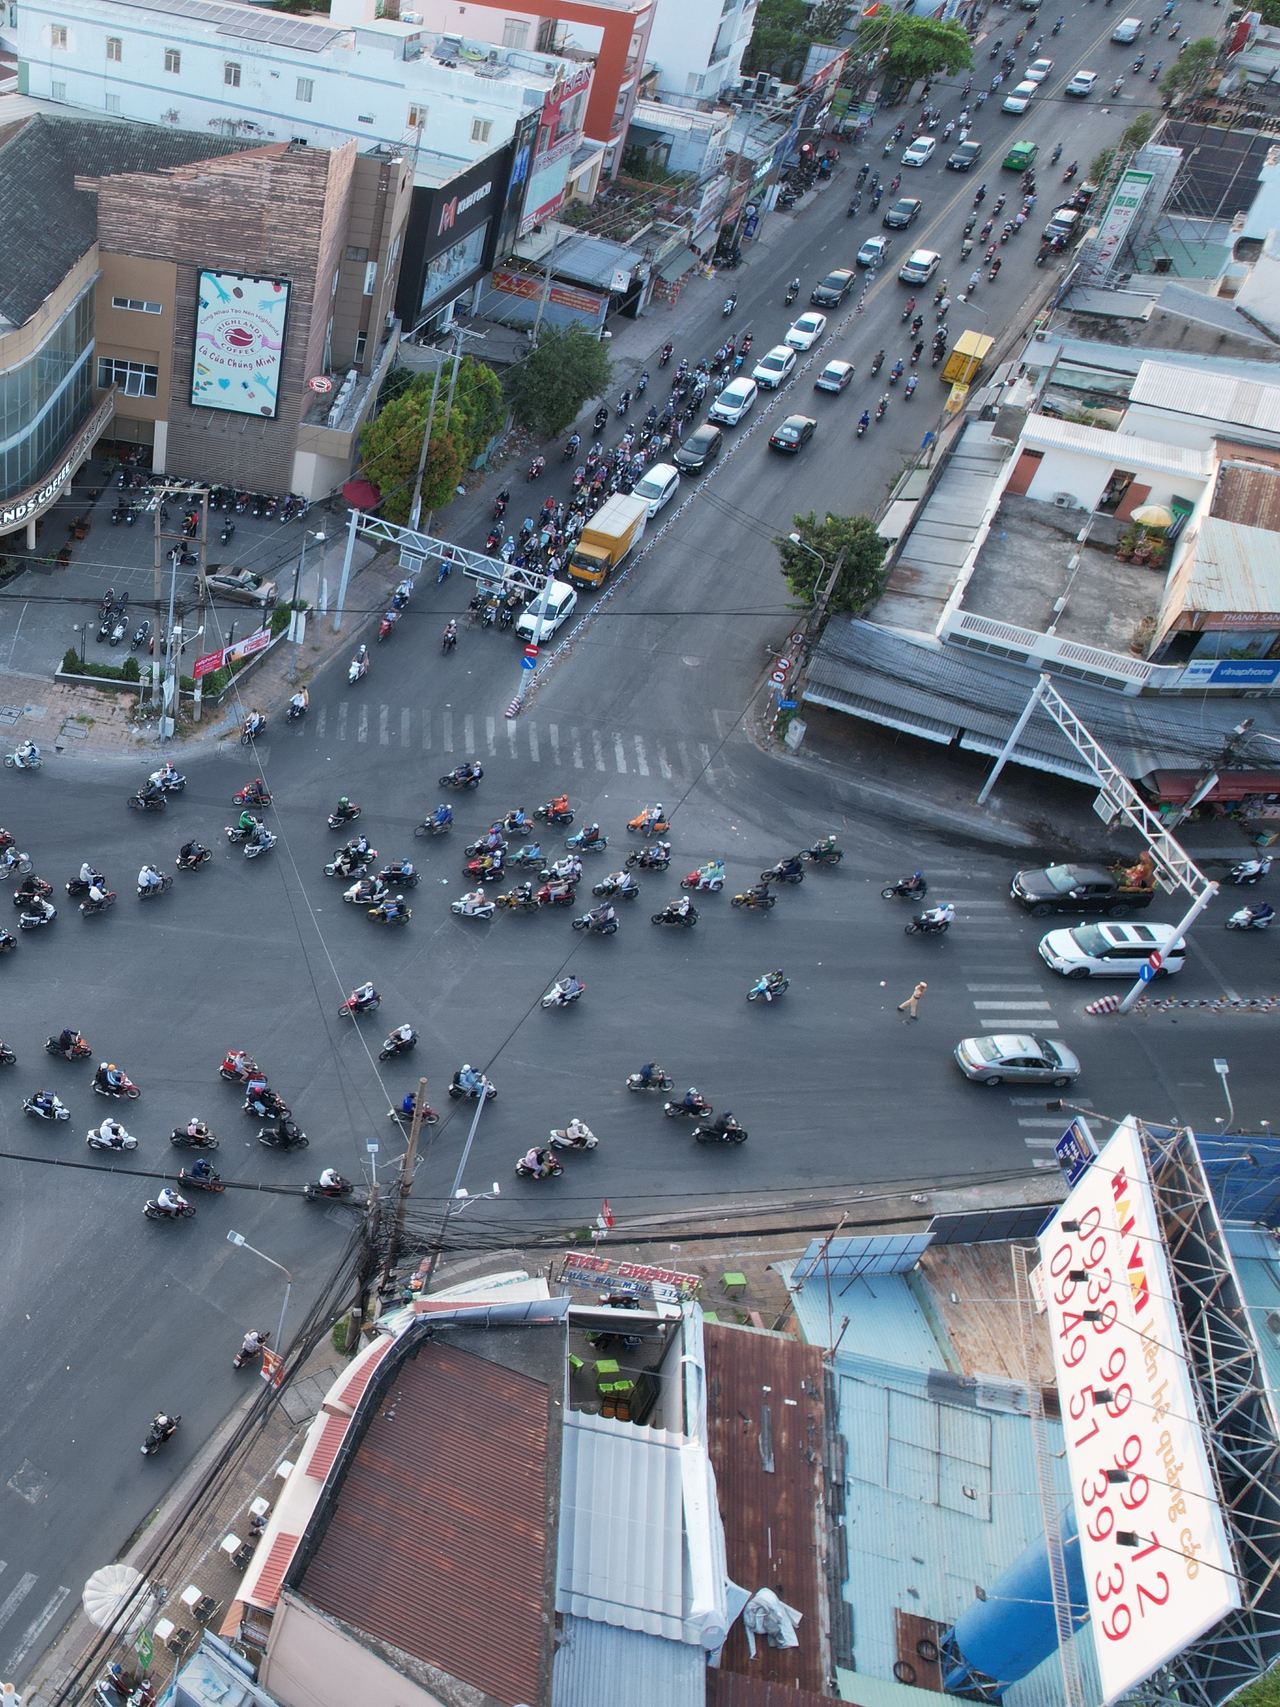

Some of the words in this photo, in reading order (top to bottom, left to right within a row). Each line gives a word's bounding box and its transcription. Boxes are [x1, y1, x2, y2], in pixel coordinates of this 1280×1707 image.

[213, 309, 229, 317] Nhau
[255, 313, 280, 337] Highlands
[216, 319, 262, 339] HIGHLANDS
[220, 342, 256, 354] COFFEE
[227, 358, 253, 370] Chúng
[38, 461, 71, 504] COFFEE
[1220, 667, 1274, 677] vinaphone
[1077, 1206, 1118, 1335] 0939
[1050, 1243, 1088, 1368] 0949
[1139, 1318, 1159, 1382] Liên
[1099, 1347, 1133, 1419] 99
[1069, 1384, 1100, 1448] 51
[1113, 1434, 1150, 1511] 99
[1081, 1468, 1115, 1542] 39
[1095, 1562, 1132, 1641] 39
[1131, 1531, 1170, 1618] 12
